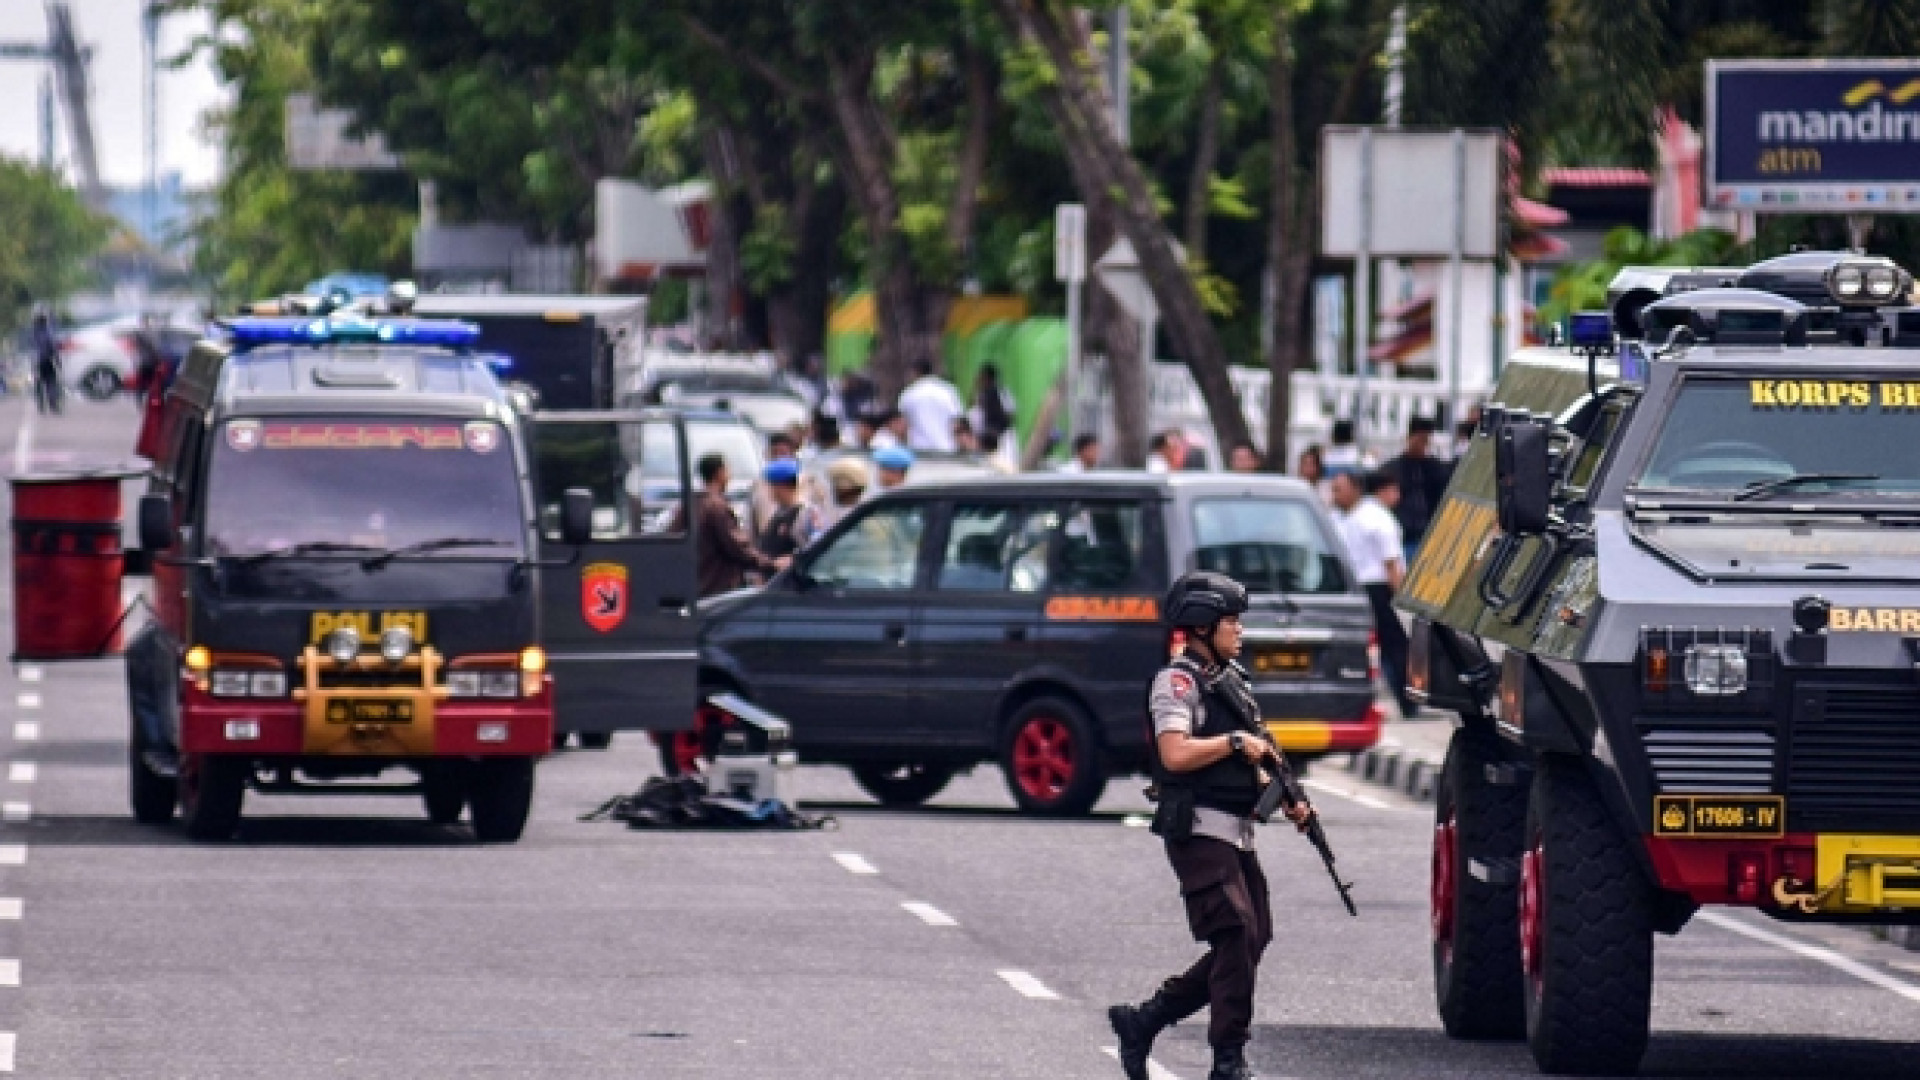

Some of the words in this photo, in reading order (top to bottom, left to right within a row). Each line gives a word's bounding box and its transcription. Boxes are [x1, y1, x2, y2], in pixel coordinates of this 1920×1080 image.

[1758, 147, 1822, 174] atm
[1750, 382, 1871, 406] KORPS
[1829, 608, 1920, 632] BARR
